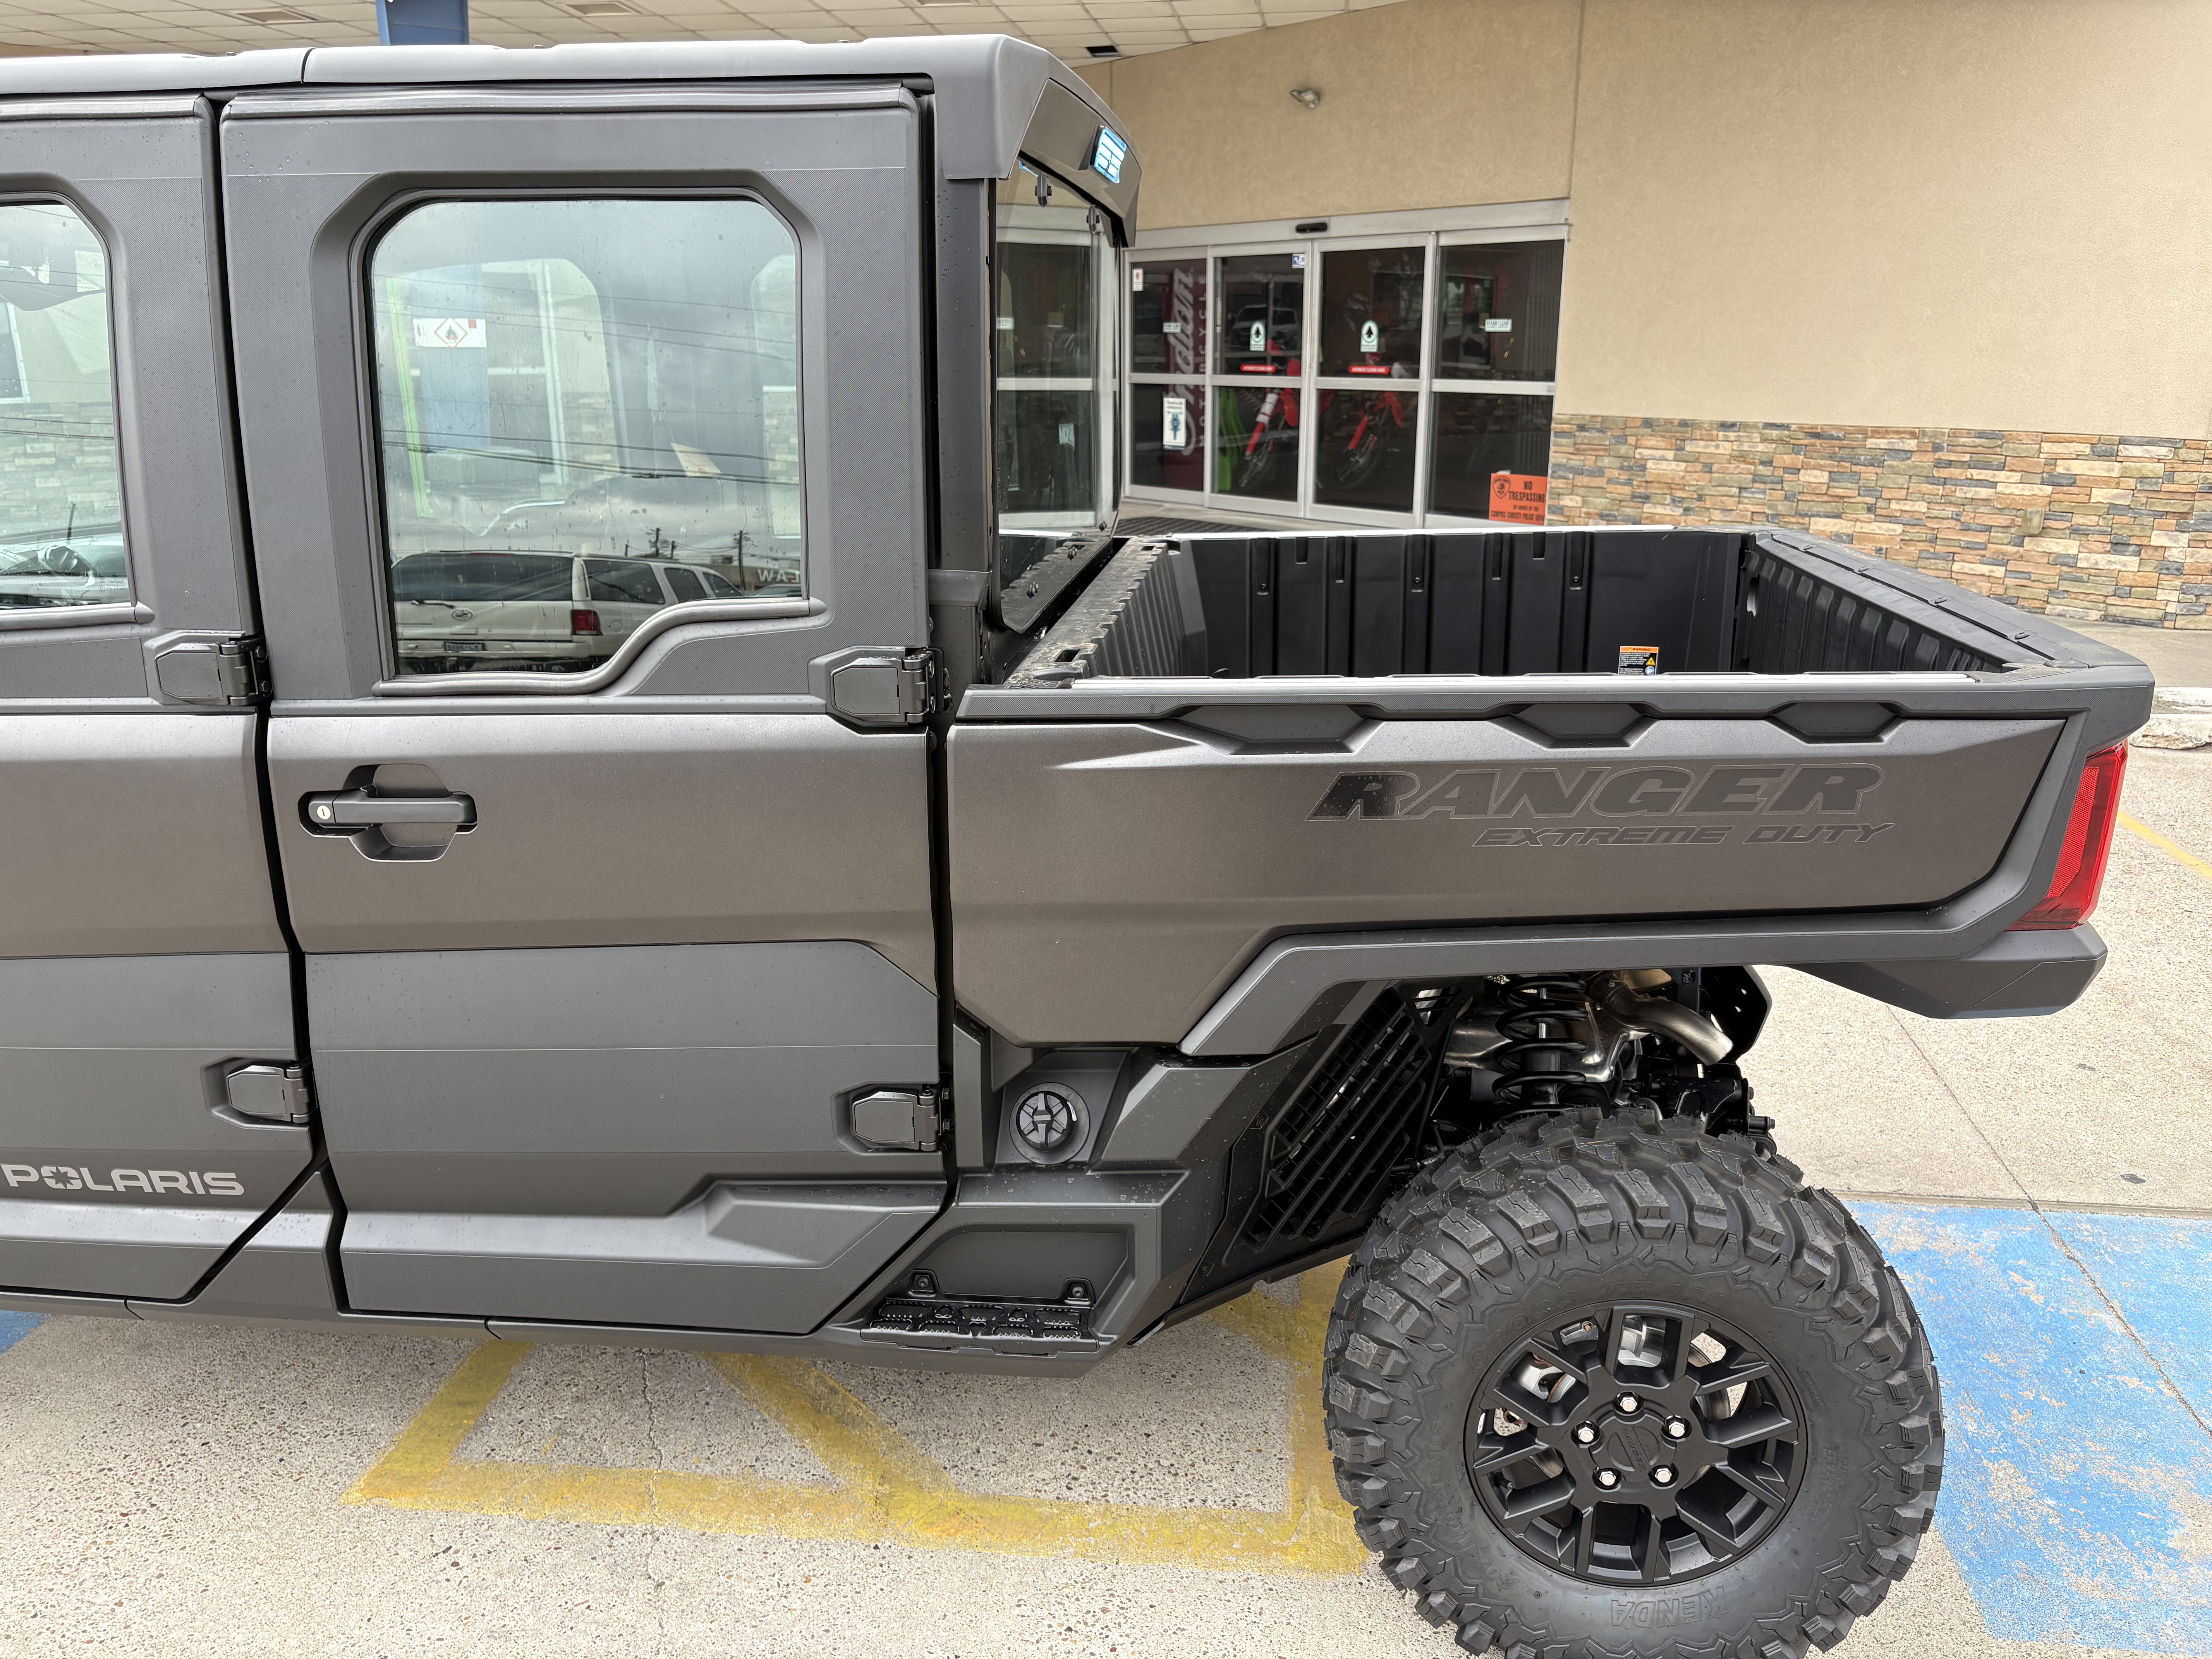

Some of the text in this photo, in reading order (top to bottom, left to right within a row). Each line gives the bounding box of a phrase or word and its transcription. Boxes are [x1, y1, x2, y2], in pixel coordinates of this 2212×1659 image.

[1508, 491, 1545, 503] TRESPASSING
[1523, 481, 1532, 490] NO
[1305, 764, 1885, 821] RANGER
[1472, 823, 1895, 847] EXTREME DUTY
[0, 1164, 244, 1196] POLARIS
[1601, 1280, 1725, 1309] TRAIL
[1621, 1427, 1647, 1471] RANGER
[1611, 1586, 1728, 1628] KENDA
